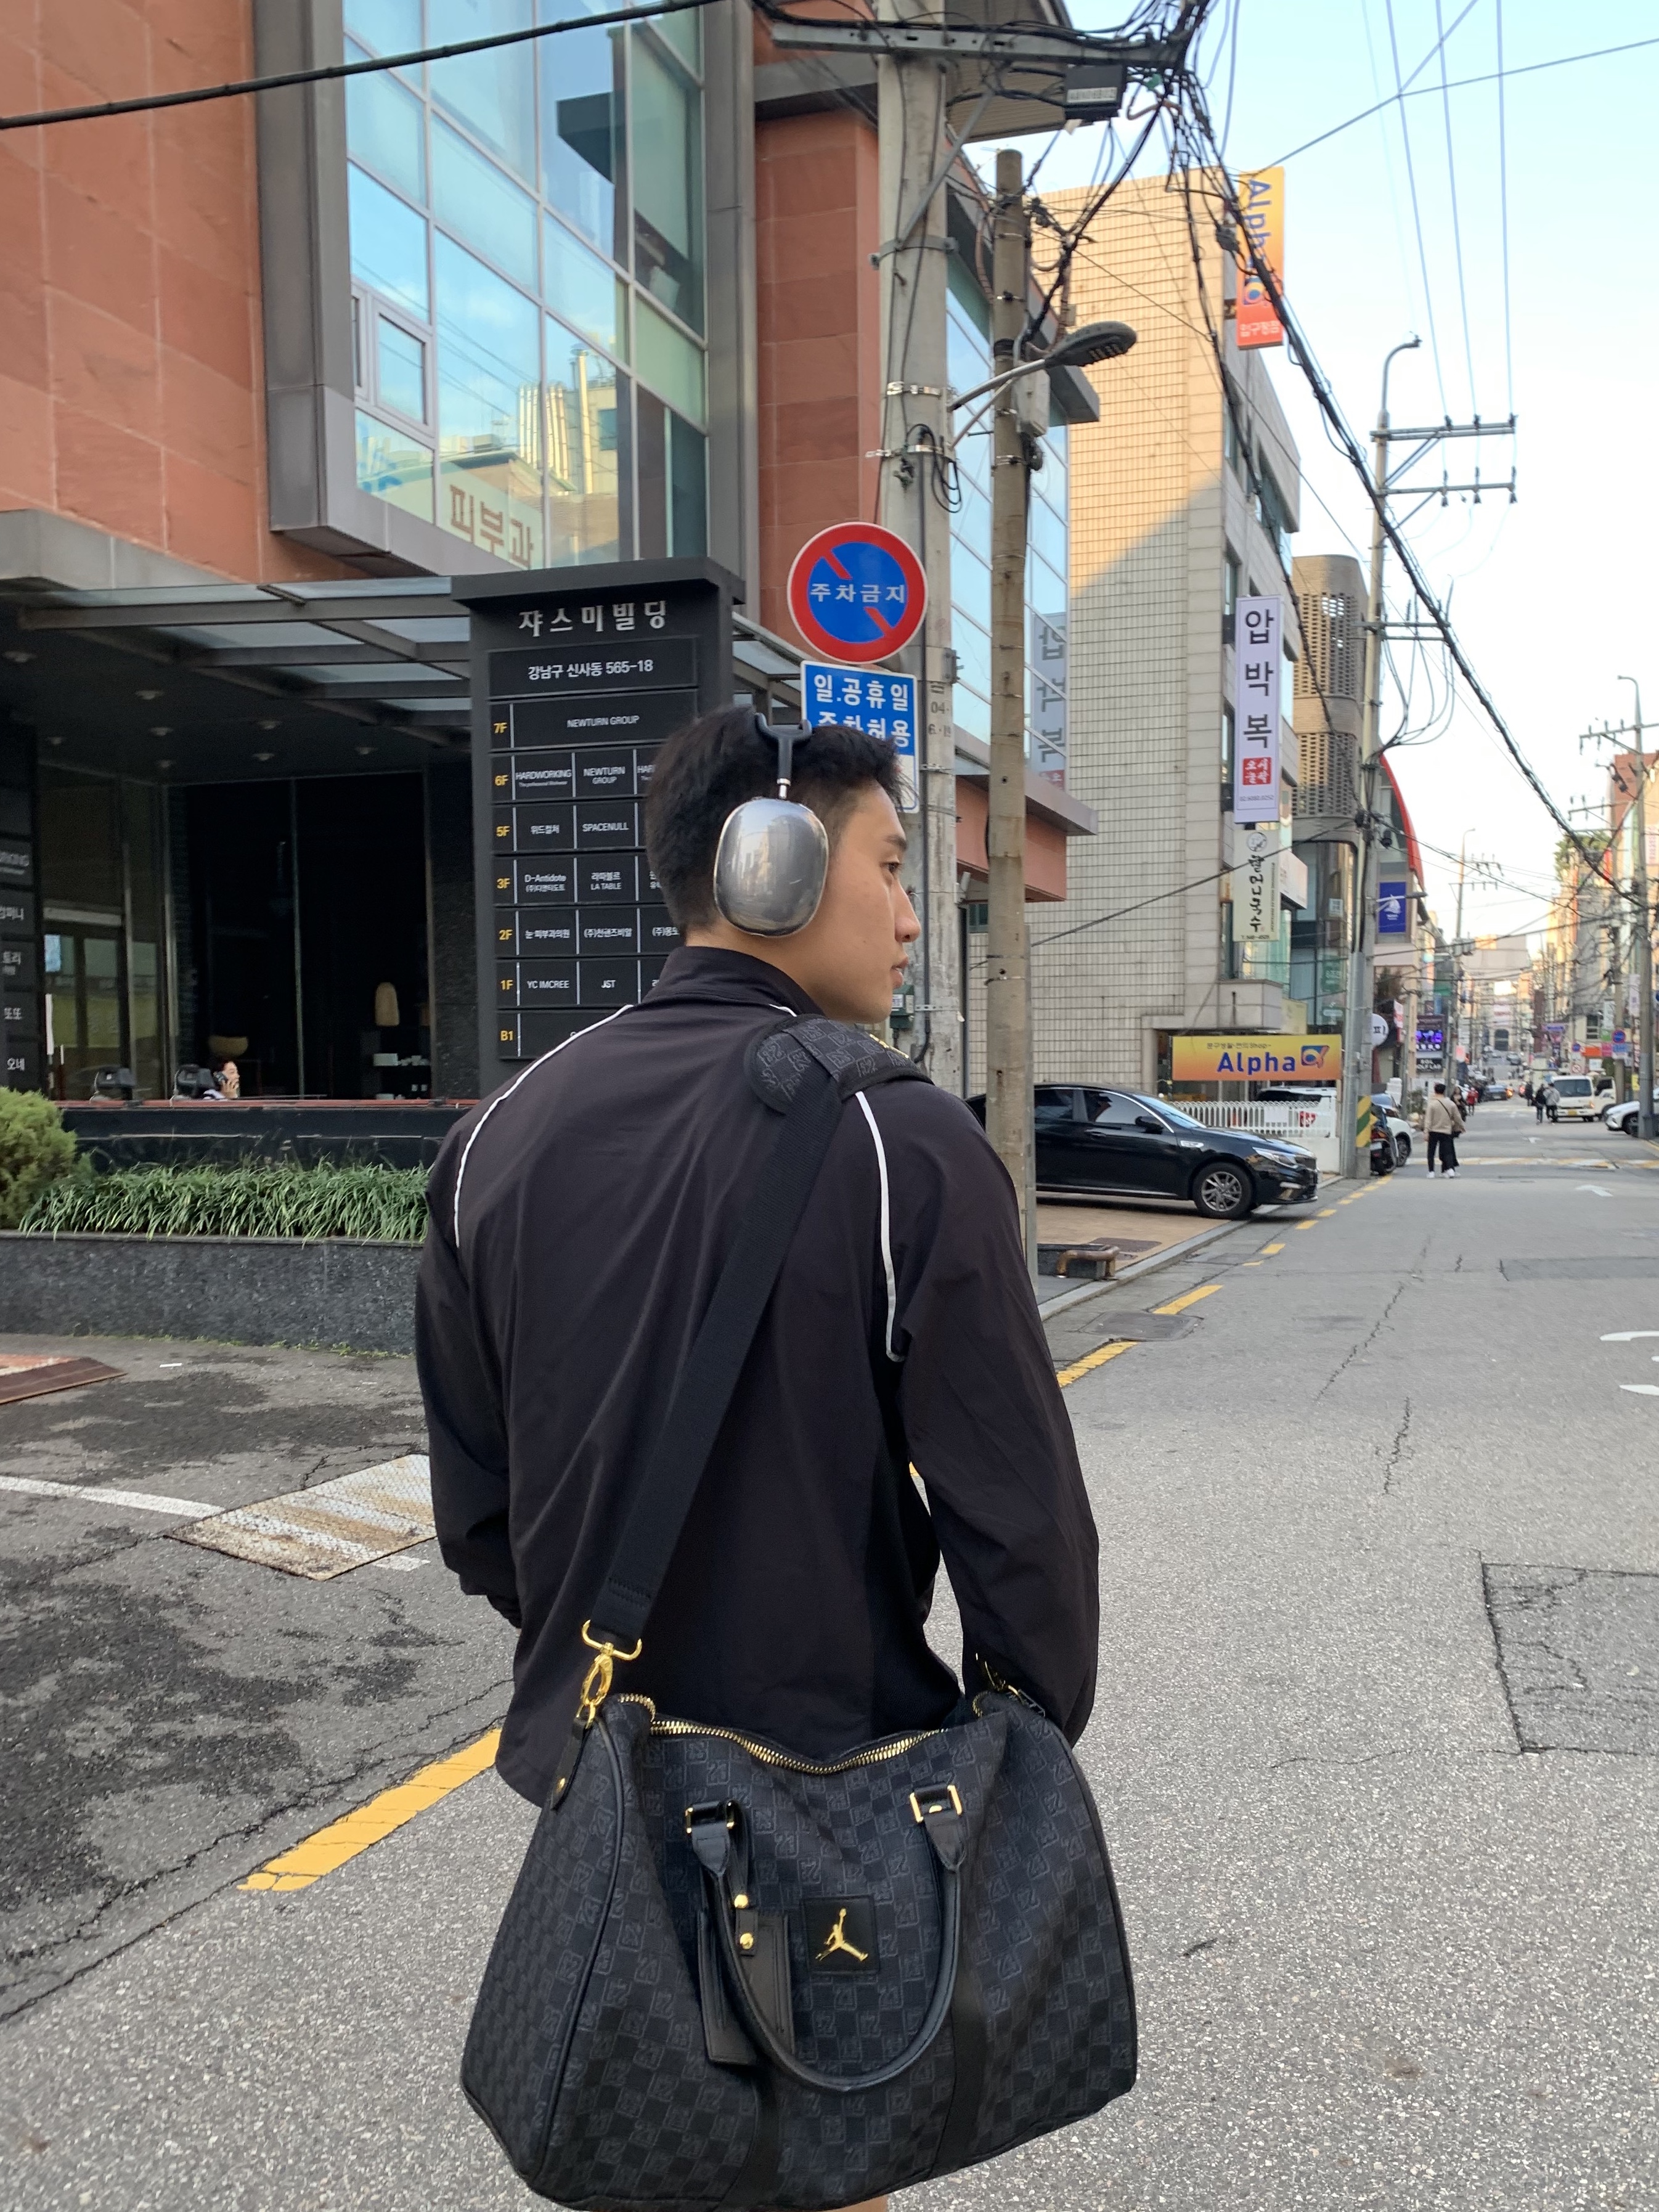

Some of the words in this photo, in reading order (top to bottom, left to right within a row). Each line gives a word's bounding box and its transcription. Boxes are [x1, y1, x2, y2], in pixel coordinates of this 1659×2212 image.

[450, 483, 534, 568] 피부과
[810, 582, 905, 603] 주차금지
[528, 664, 564, 680] 강남구
[566, 662, 603, 678] 신사동
[606, 659, 653, 674] 565-18
[1245, 608, 1274, 749] 압박복
[567, 717, 609, 728] NEWTURN
[609, 715, 640, 725] GROUP
[493, 722, 507, 733] 7F
[515, 769, 572, 780] HARDWORKING
[582, 766, 626, 777] NEWTURN
[494, 774, 508, 786] 6F
[592, 776, 618, 785] GROUP
[496, 825, 510, 837] 5F
[582, 822, 629, 832] SPACENULL
[497, 878, 510, 889] 3F
[590, 883, 603, 891] LA
[601, 882, 622, 890] TABLE
[499, 929, 513, 941] 2F
[500, 979, 513, 990] 1F
[526, 980, 539, 989] YC
[539, 980, 569, 989] IMCREE
[601, 979, 616, 989] JST
[500, 1030, 513, 1041] B1
[1217, 1051, 1295, 1075] Alpha
